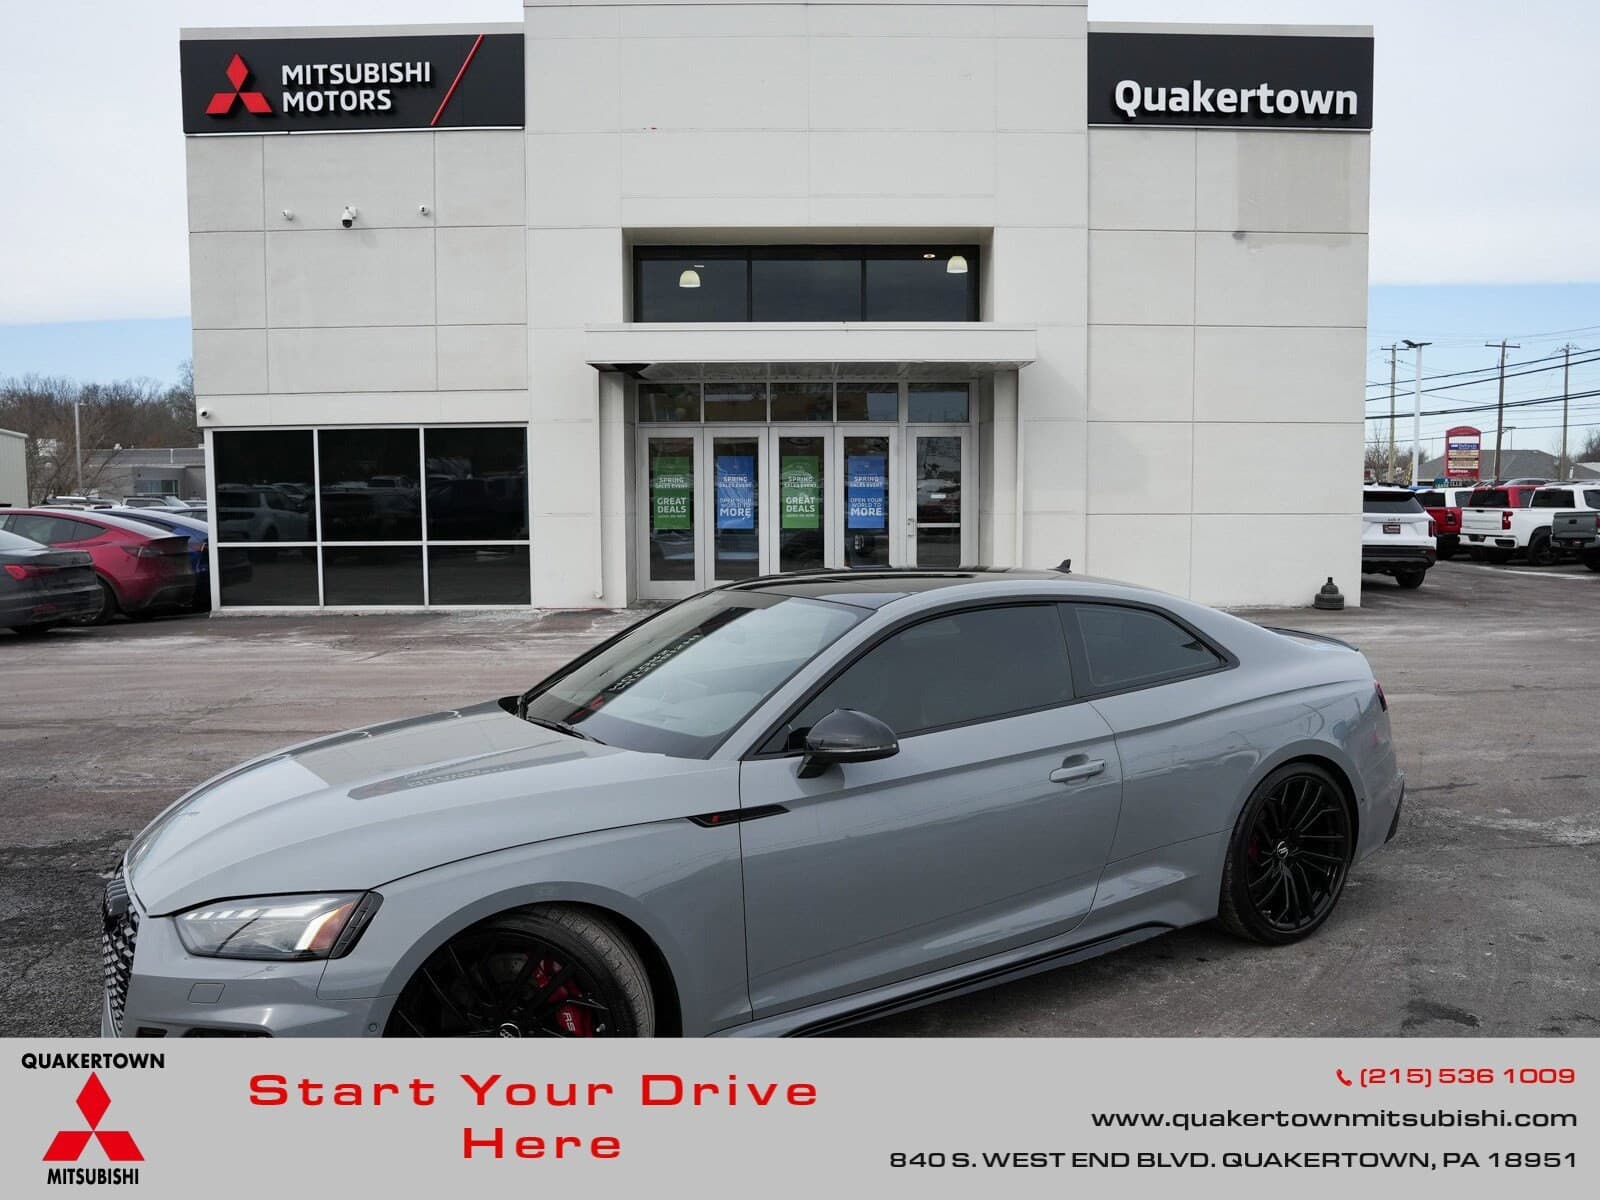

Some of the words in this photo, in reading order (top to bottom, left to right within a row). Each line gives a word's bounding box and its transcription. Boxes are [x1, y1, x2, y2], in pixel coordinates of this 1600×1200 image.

[281, 61, 431, 85] MITSUBISHI
[282, 89, 392, 112] MOTORS
[1115, 79, 1358, 117] Quakertown
[657, 497, 687, 505] GREAT
[785, 496, 815, 505] GREAT
[657, 505, 687, 513] DEALS
[720, 508, 752, 517] MORE
[786, 504, 816, 513] DEALS
[850, 507, 883, 517] MORE
[562, 1012, 576, 1032] RS
